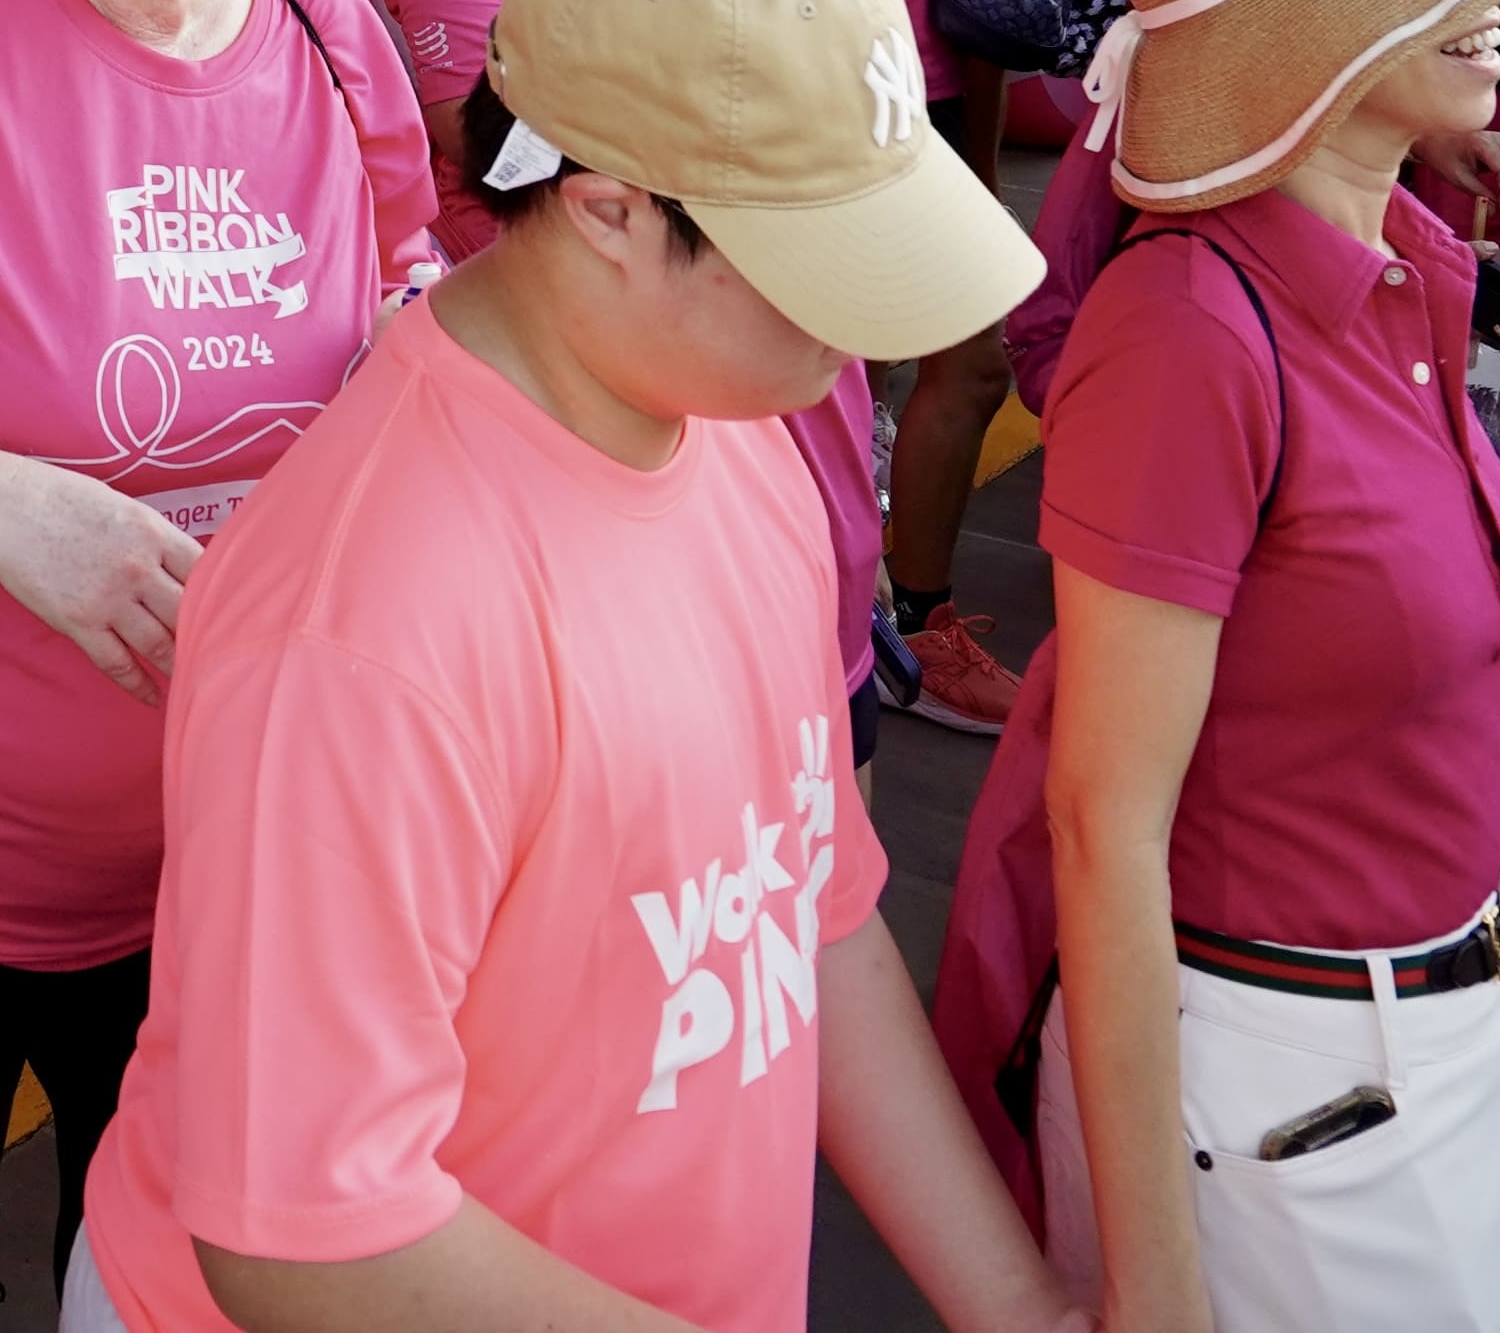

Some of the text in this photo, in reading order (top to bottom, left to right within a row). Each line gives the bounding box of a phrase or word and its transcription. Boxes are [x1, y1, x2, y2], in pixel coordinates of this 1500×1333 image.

[144, 164, 251, 213] PINK
[112, 208, 295, 253] RIBBON
[143, 263, 280, 309] WALK
[183, 333, 274, 370] 2024
